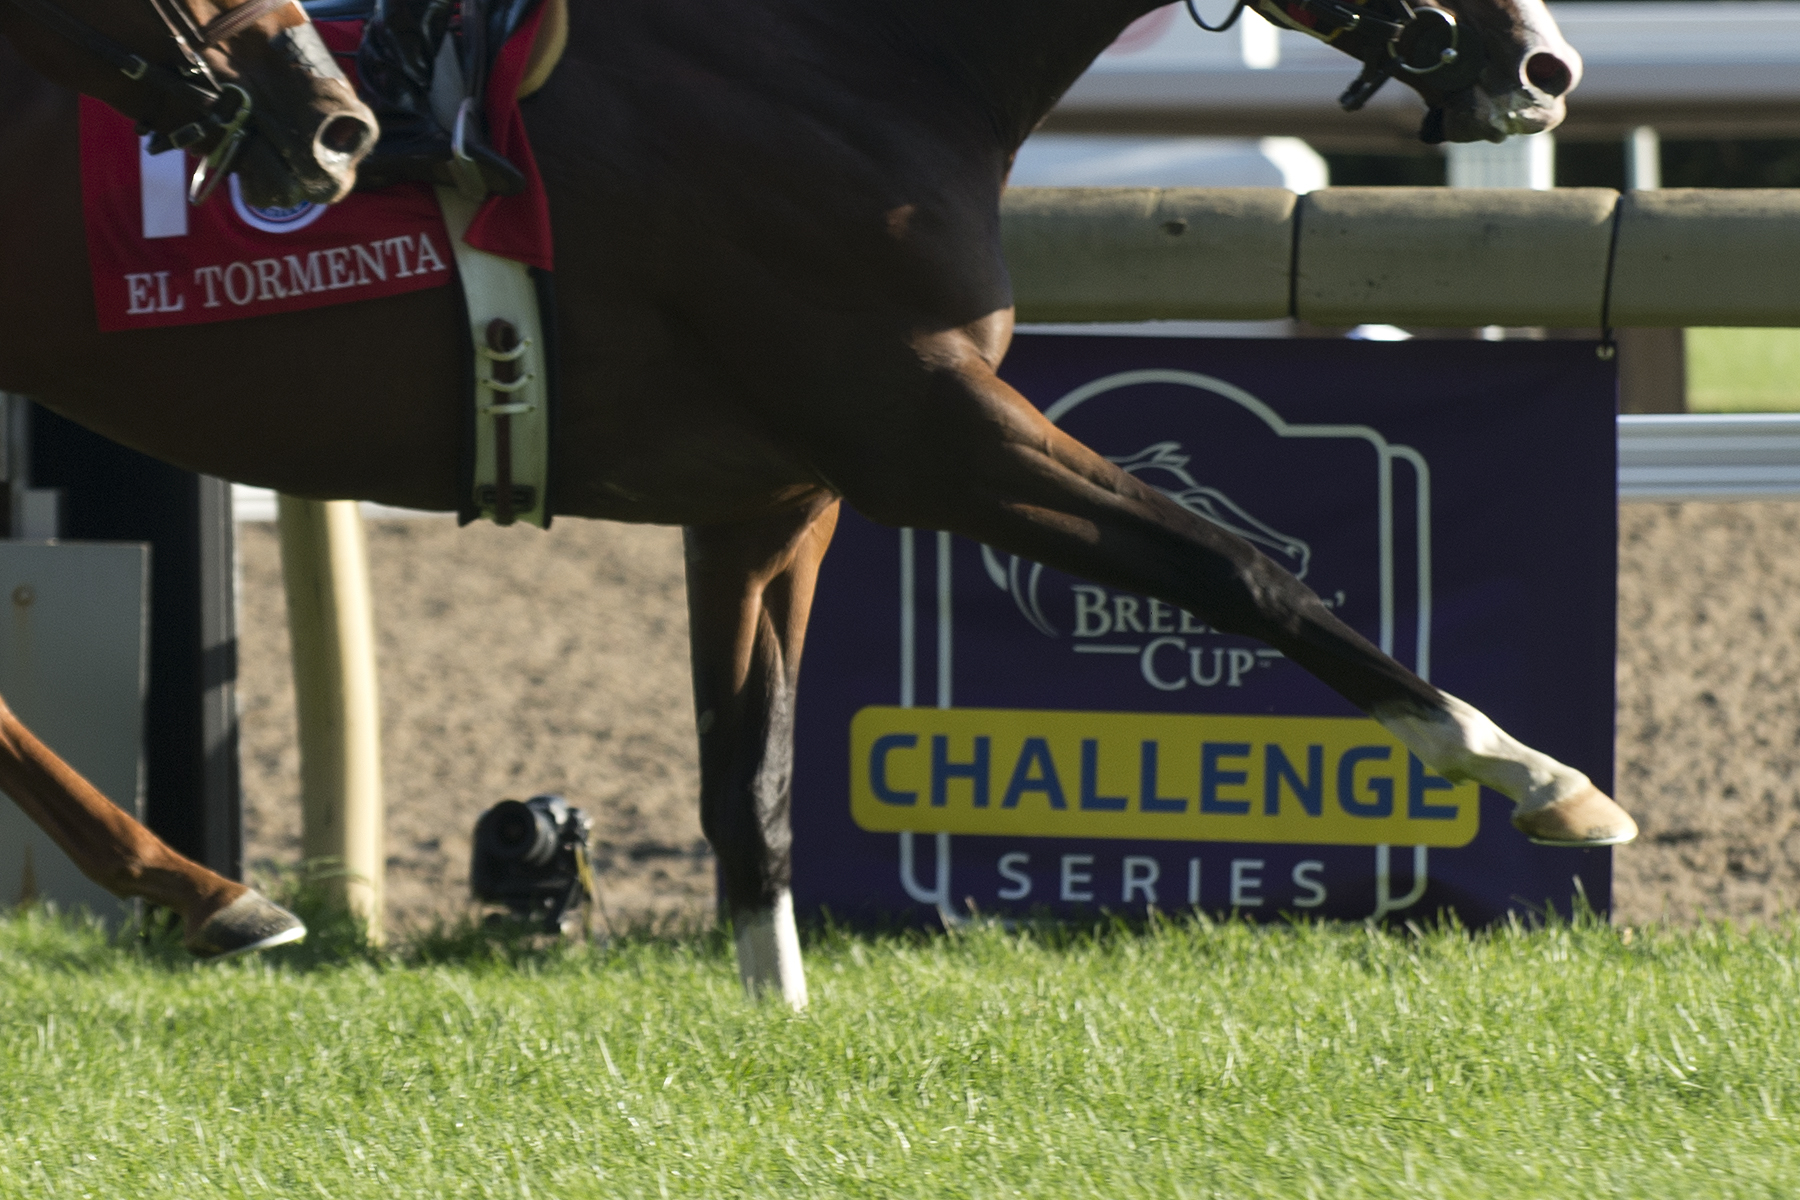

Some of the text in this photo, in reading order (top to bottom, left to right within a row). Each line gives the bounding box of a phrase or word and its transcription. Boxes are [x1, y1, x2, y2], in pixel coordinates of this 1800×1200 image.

[124, 232, 447, 314] EL TORMENTA
[868, 732, 1462, 820] CHALLENGE
[997, 852, 1329, 907] SERIES
